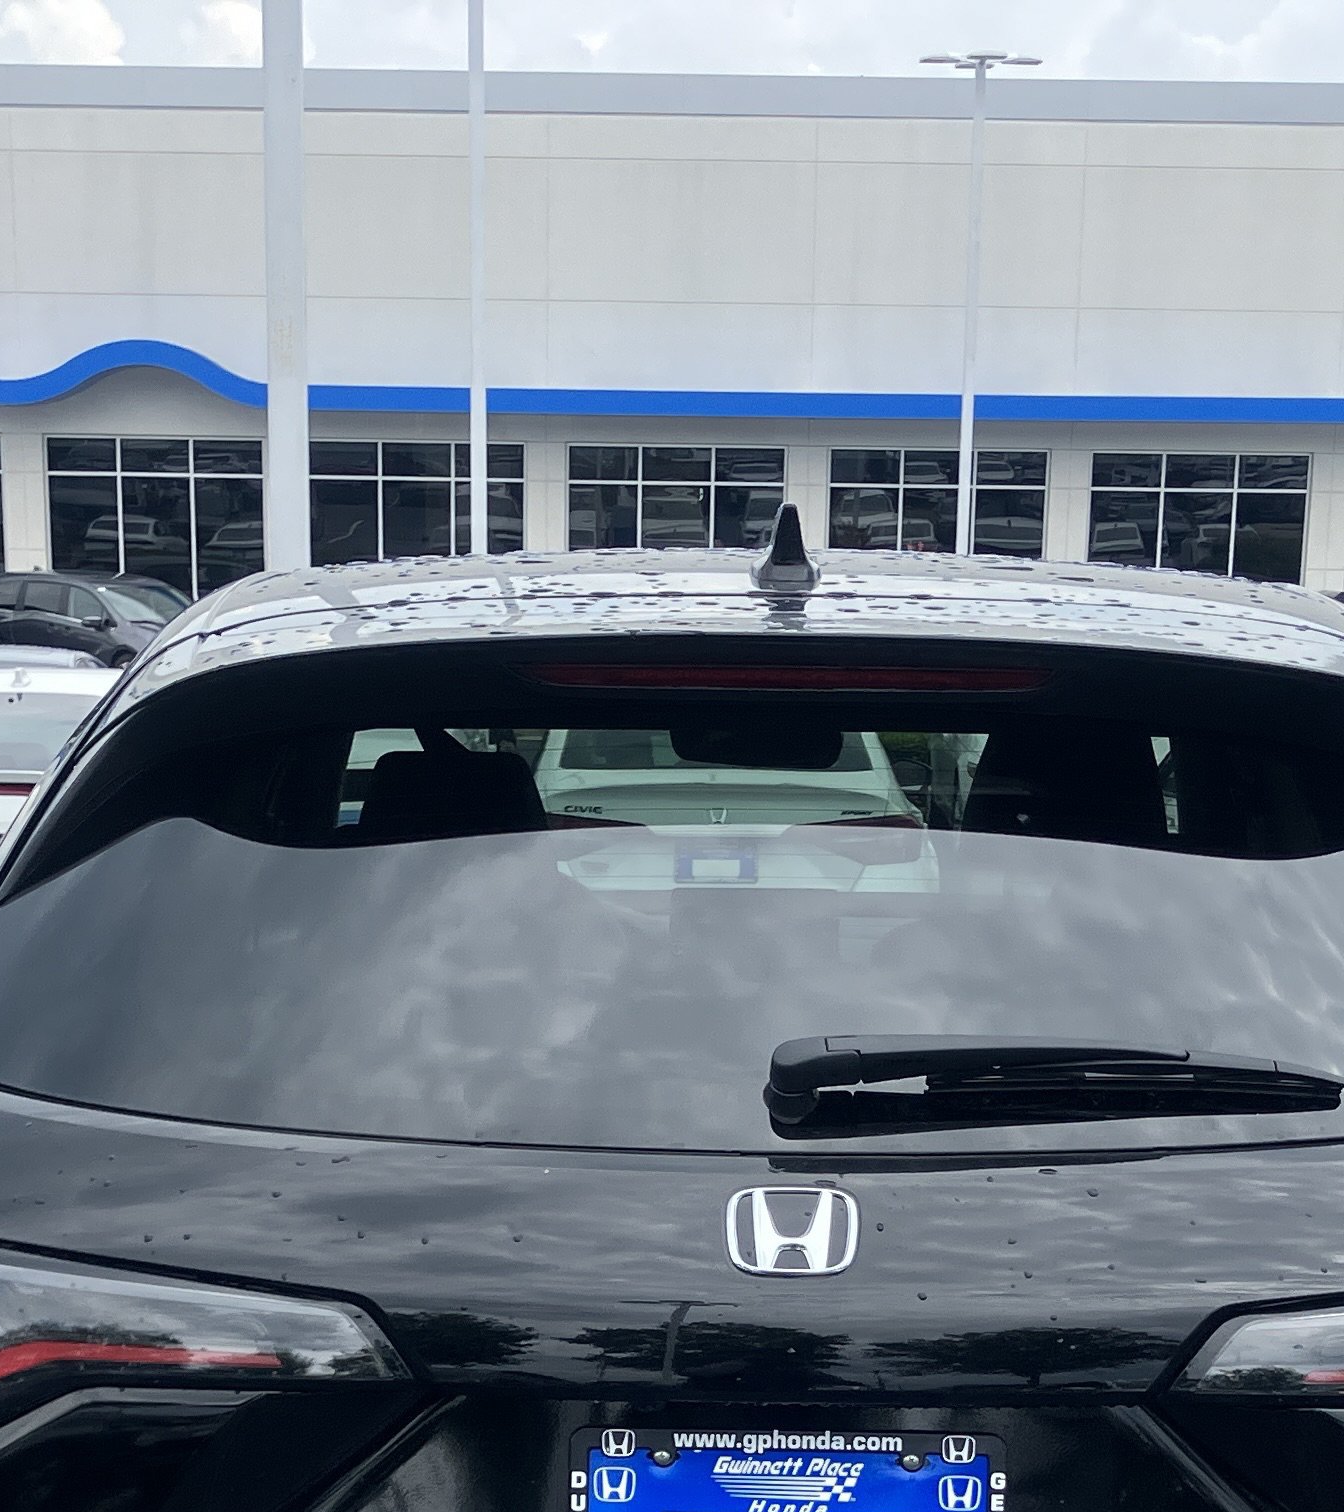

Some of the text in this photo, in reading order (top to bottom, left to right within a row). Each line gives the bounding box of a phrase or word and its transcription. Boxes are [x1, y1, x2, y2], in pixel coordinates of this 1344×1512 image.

[673, 1429, 904, 1454] www.gphonda.com
[713, 1455, 865, 1478] Gwinnett Place
